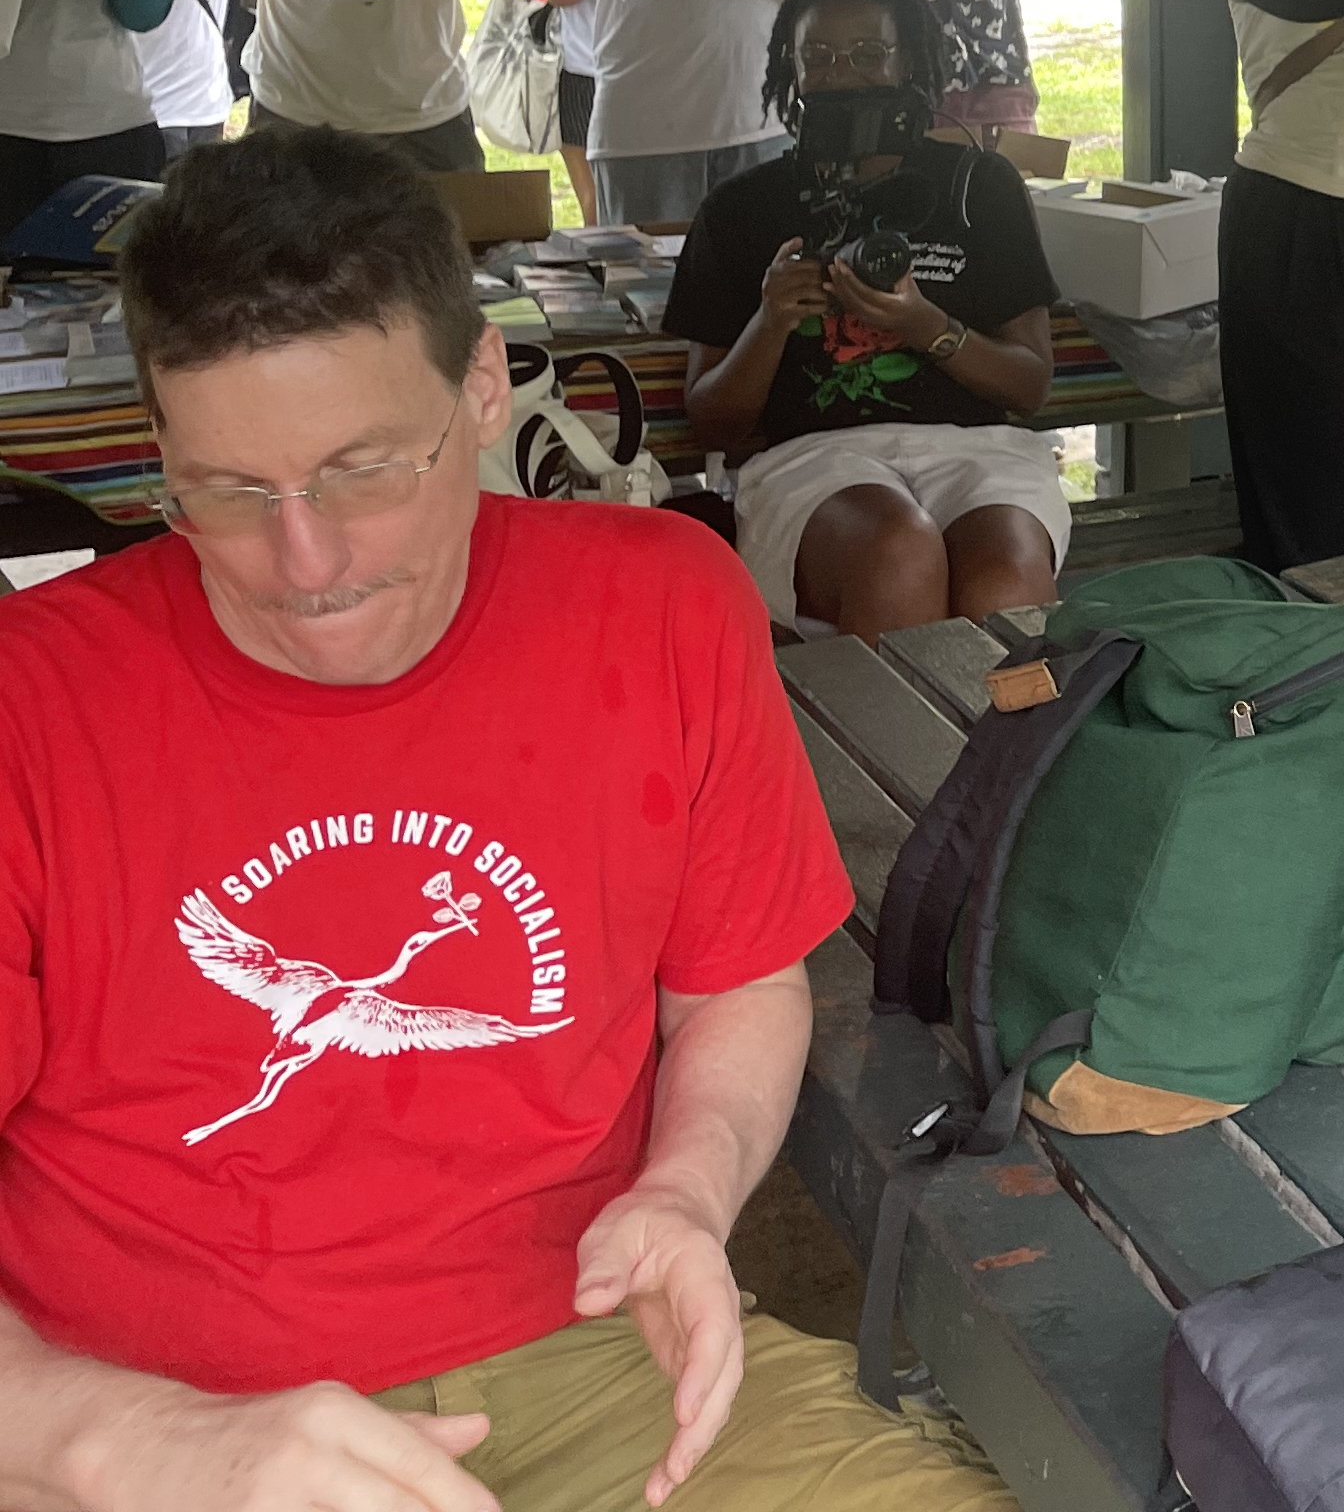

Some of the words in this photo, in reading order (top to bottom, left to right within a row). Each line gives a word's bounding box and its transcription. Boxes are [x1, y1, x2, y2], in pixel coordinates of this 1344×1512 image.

[221, 812, 374, 905] SOARING
[391, 810, 473, 857] INTO
[473, 841, 567, 1015] SOCIALISM
